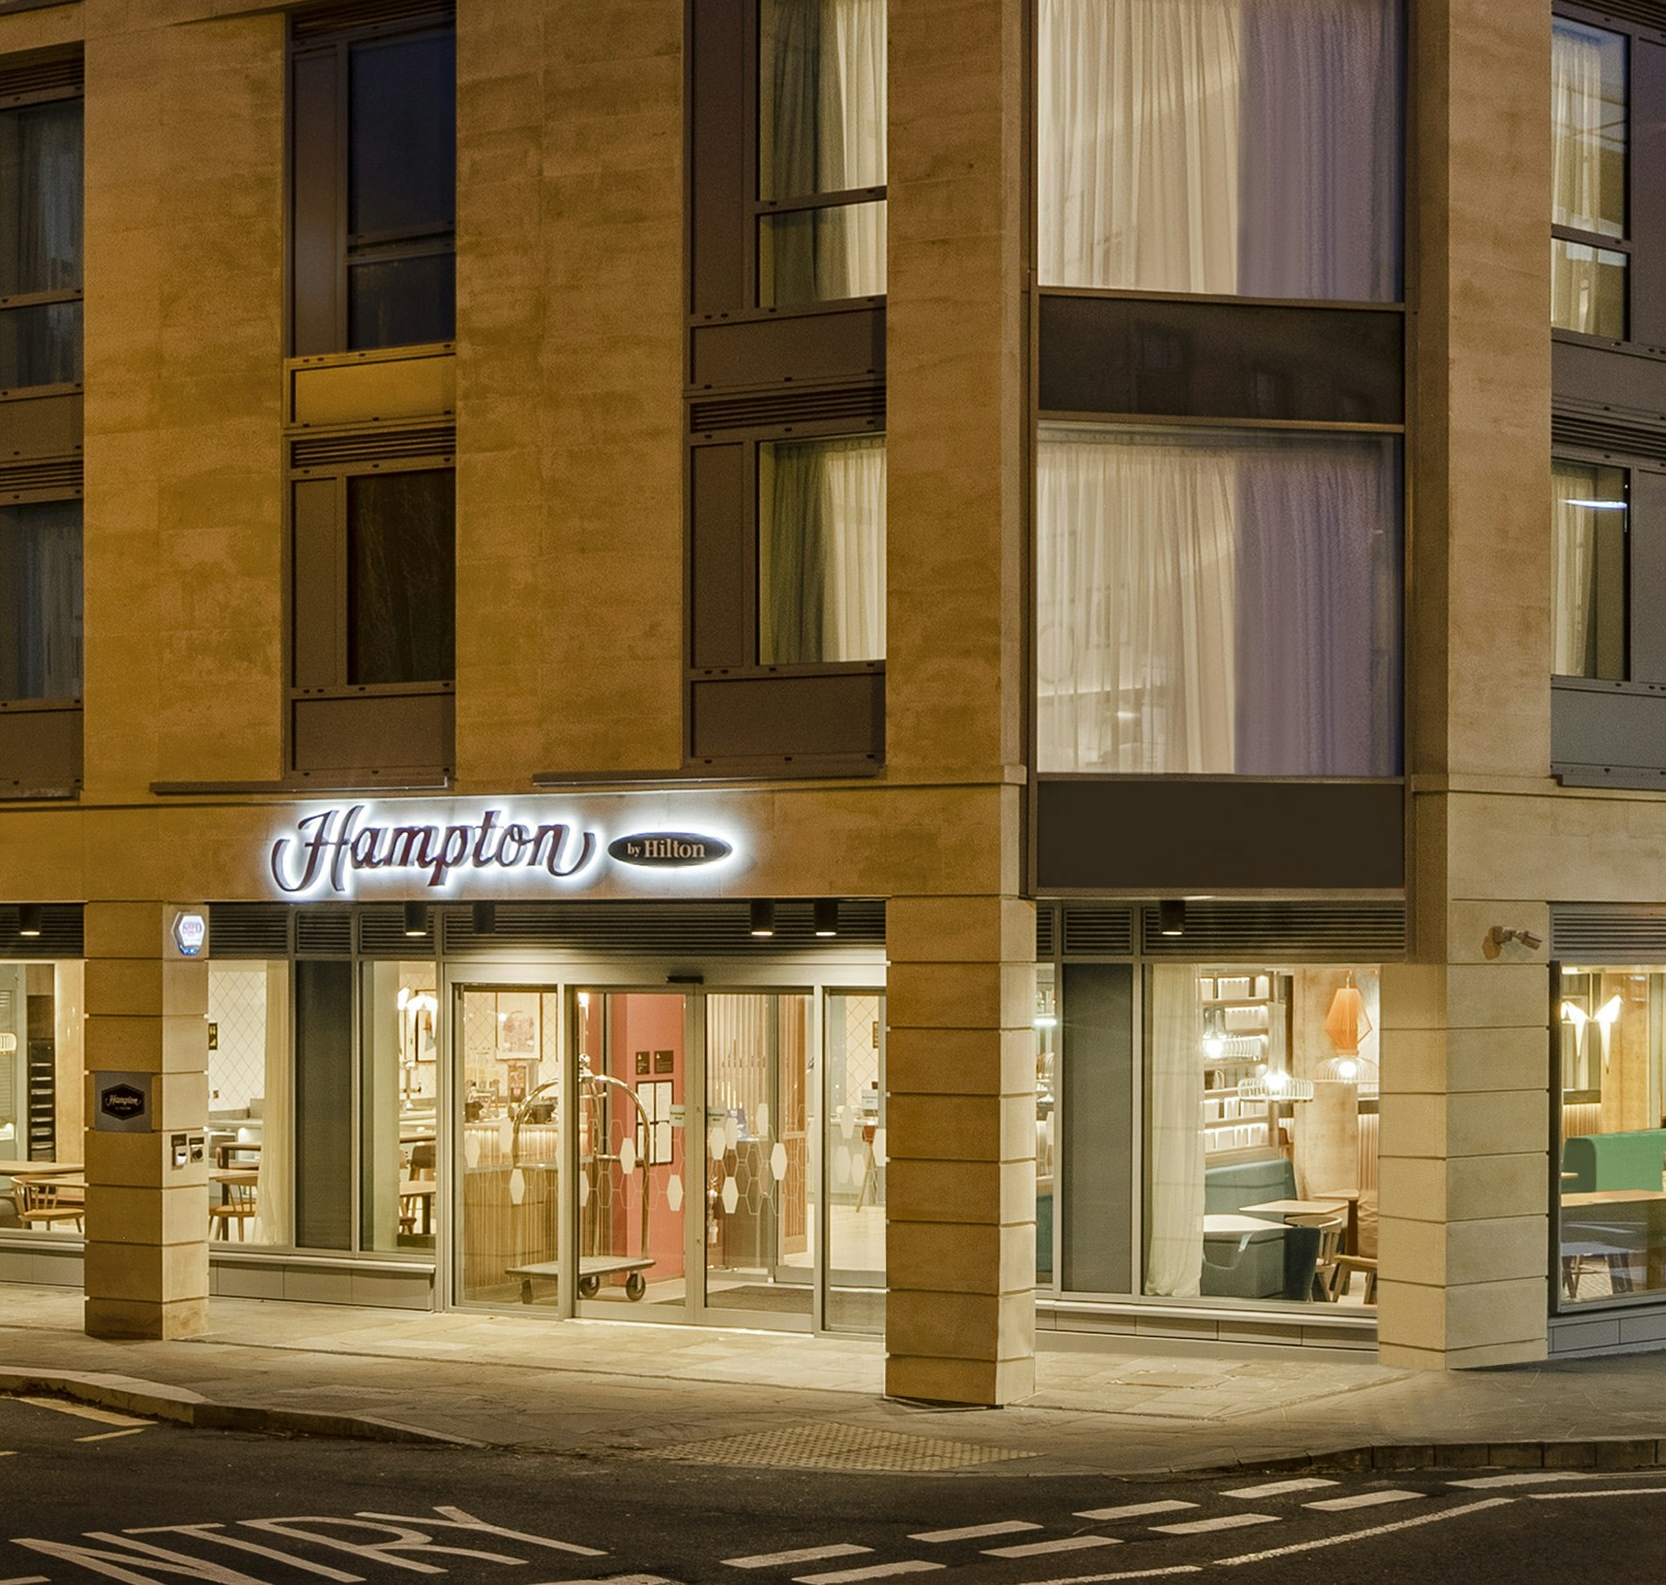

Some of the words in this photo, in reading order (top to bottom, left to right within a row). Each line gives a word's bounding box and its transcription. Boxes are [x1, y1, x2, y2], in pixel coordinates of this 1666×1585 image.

[271, 804, 596, 893] Hampton
[627, 843, 641, 858] by
[643, 839, 705, 858] Hilton
